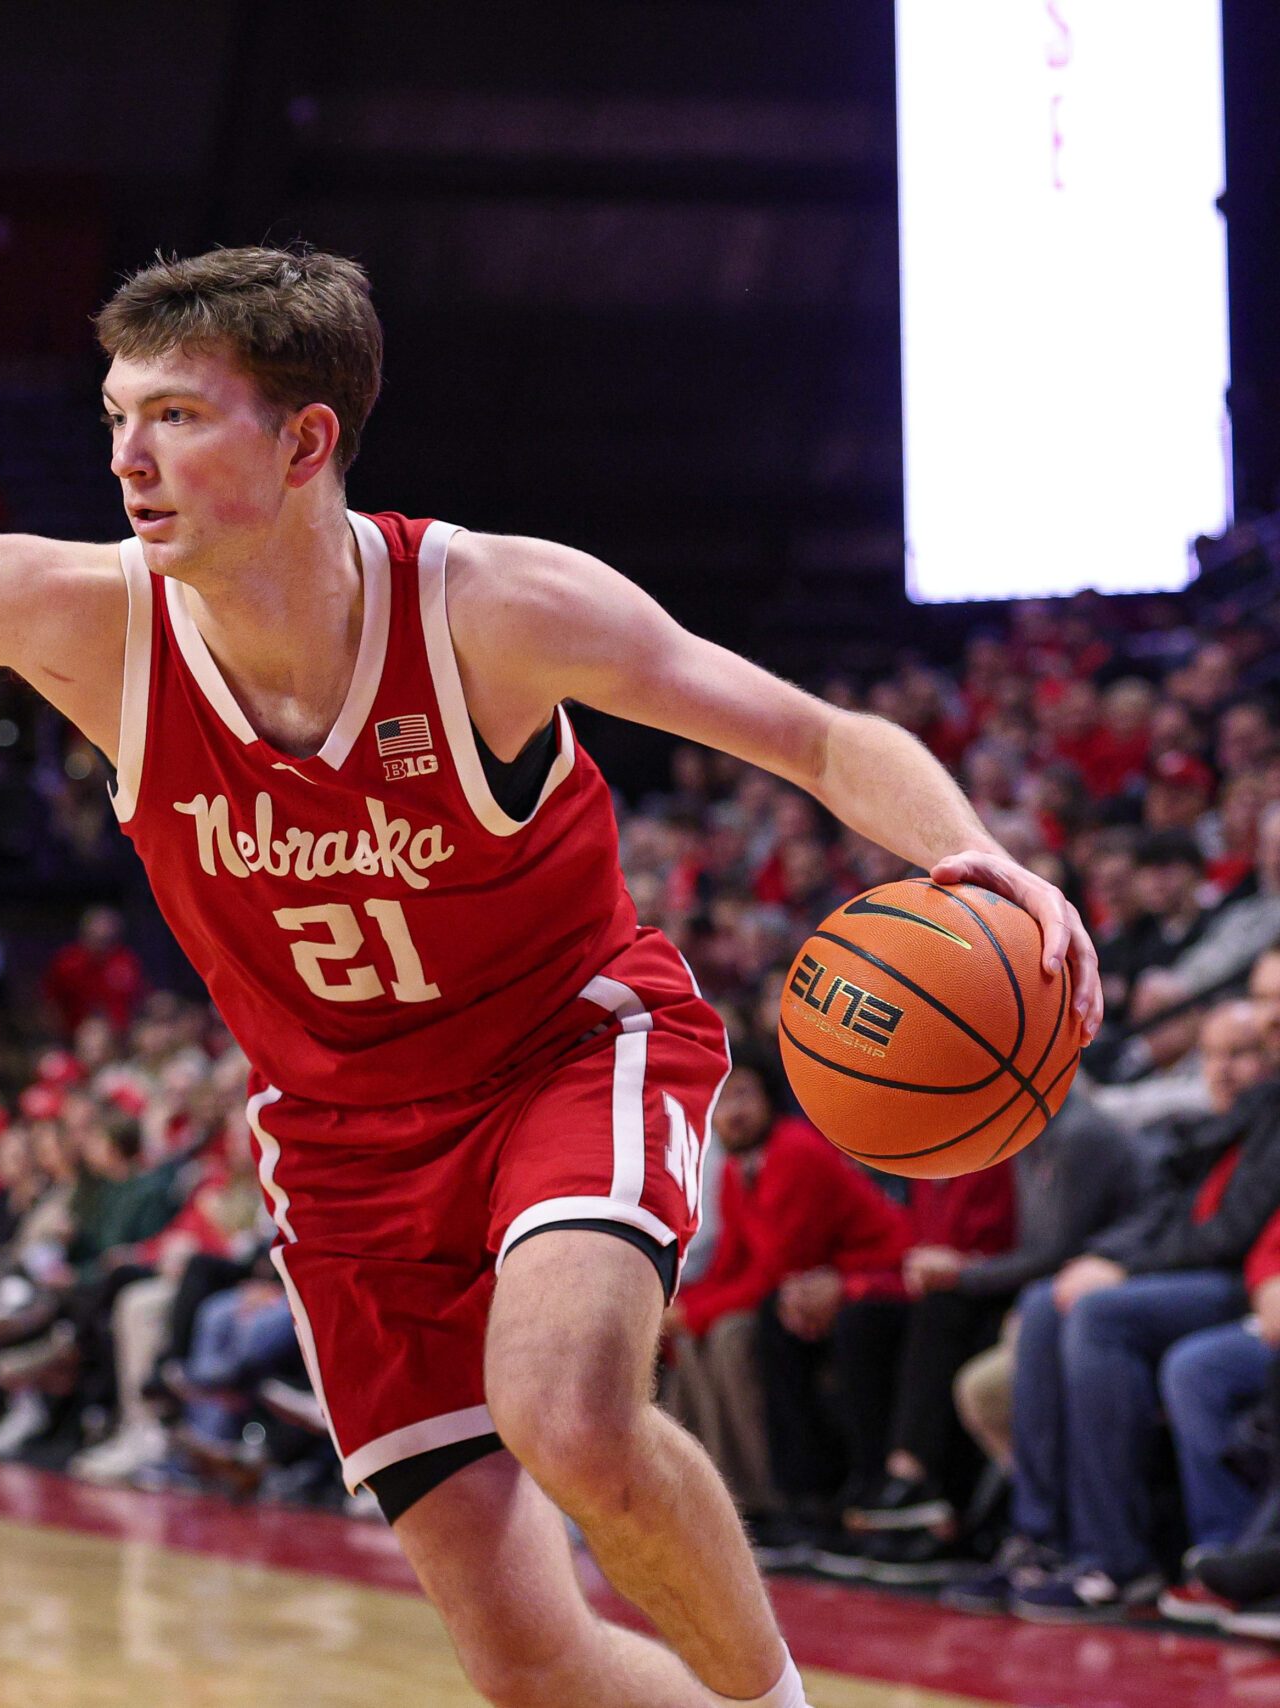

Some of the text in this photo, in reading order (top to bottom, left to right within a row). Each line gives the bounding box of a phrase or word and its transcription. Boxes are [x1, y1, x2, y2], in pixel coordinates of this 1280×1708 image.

[173, 791, 455, 889] Nebraska
[272, 898, 442, 1002] 21
[789, 953, 905, 1048] ELITE
[662, 1090, 700, 1222] N
